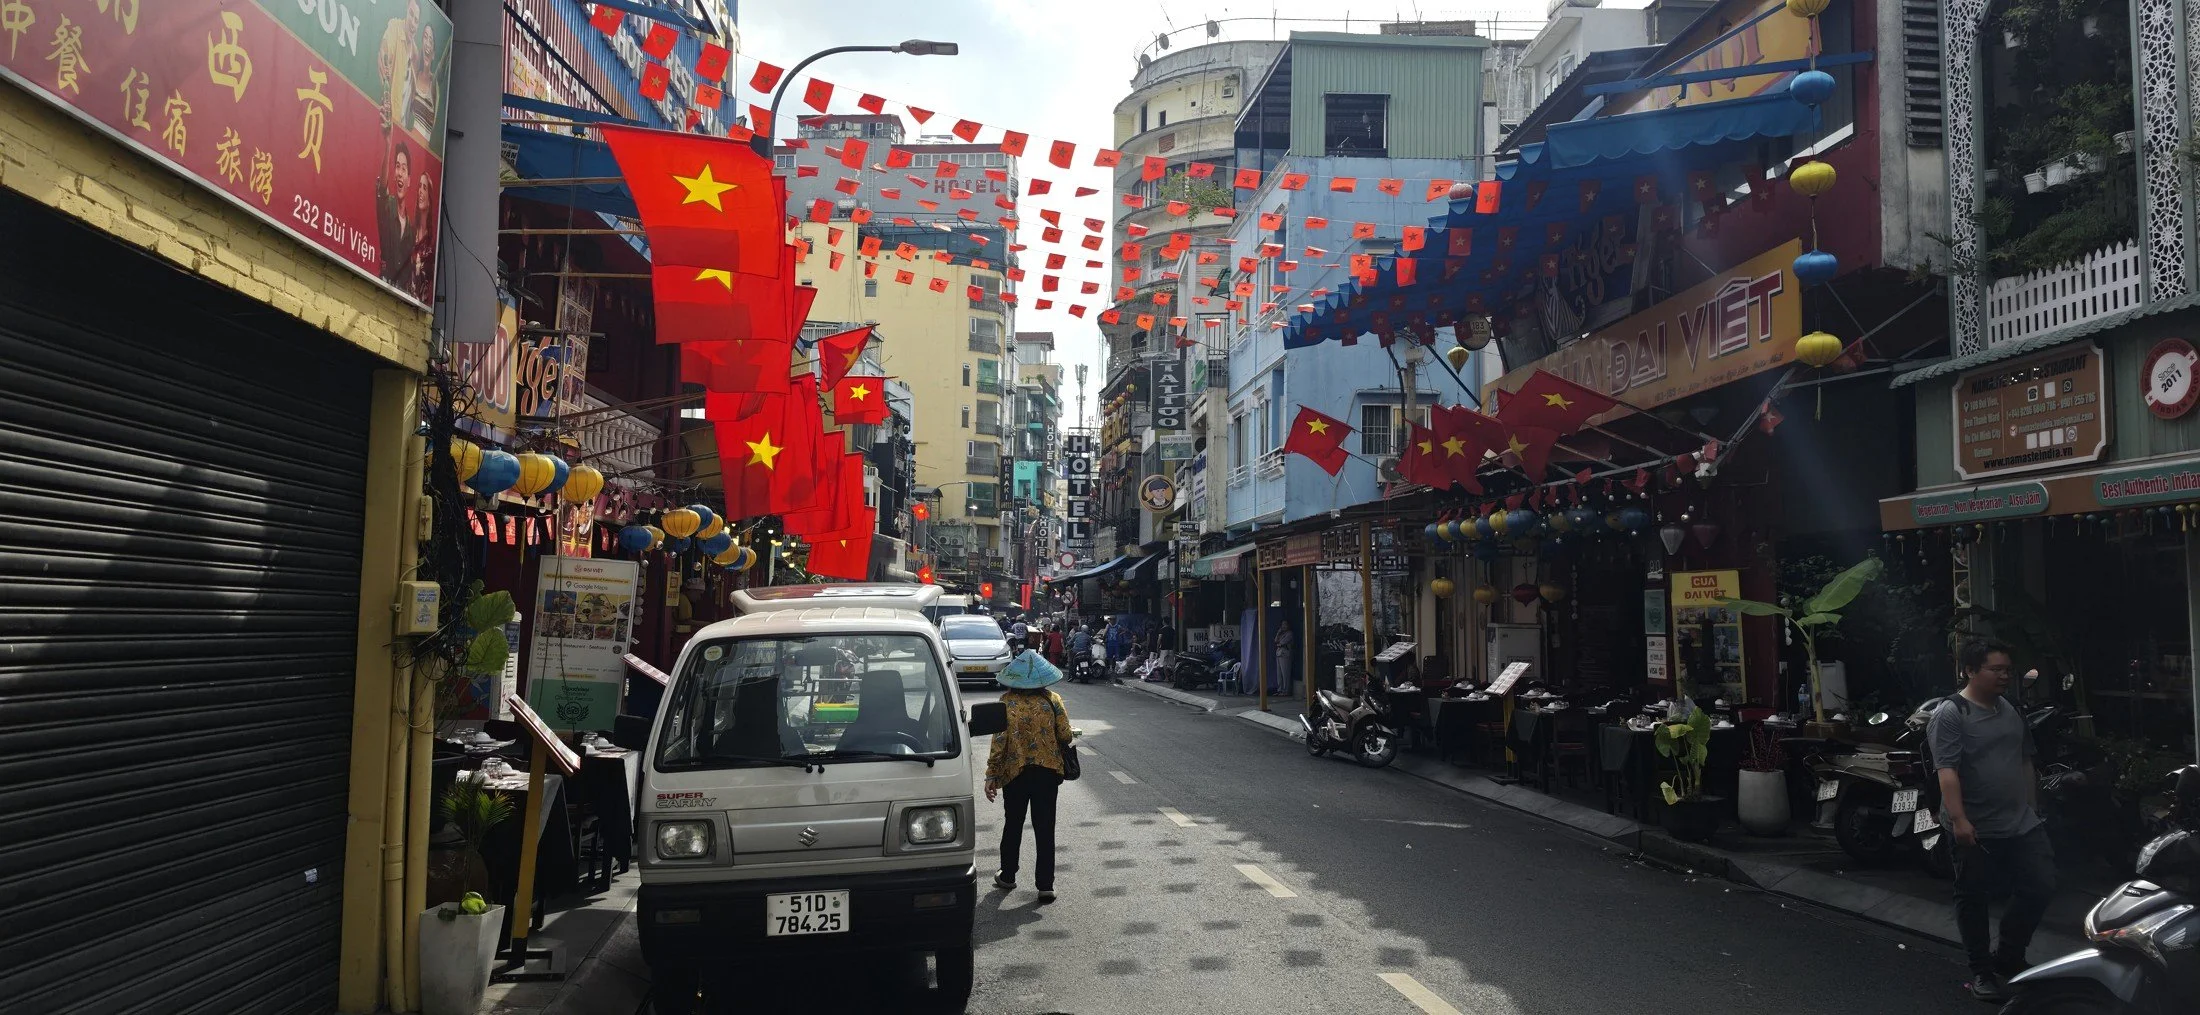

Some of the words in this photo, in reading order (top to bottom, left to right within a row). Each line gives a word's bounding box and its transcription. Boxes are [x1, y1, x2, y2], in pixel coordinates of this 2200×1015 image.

[120, 67, 193, 157] 住宿
[216, 127, 274, 205] 旅游
[933, 178, 1001, 194] HOTEL
[293, 195, 320, 230] 232
[324, 211, 346, 244] Bùi
[349, 230, 376, 263] Viện
[2157, 362, 2176, 381] Since
[2161, 369, 2183, 393] 2011
[1158, 363, 1179, 427] TATTOO
[1984, 446, 2073, 469] www.namasteindia.vn
[1072, 436, 1087, 538] HOTEL
[2101, 481, 2123, 499] Best
[2124, 475, 2169, 496] Authentic
[573, 583, 593, 591] Google
[1692, 577, 1716, 586] CUA
[1219, 630, 1234, 639] 183
[655, 797, 718, 809] CARRY
[656, 792, 704, 800] SUPER
[790, 894, 826, 913] 51D
[775, 913, 842, 934] 784.25
